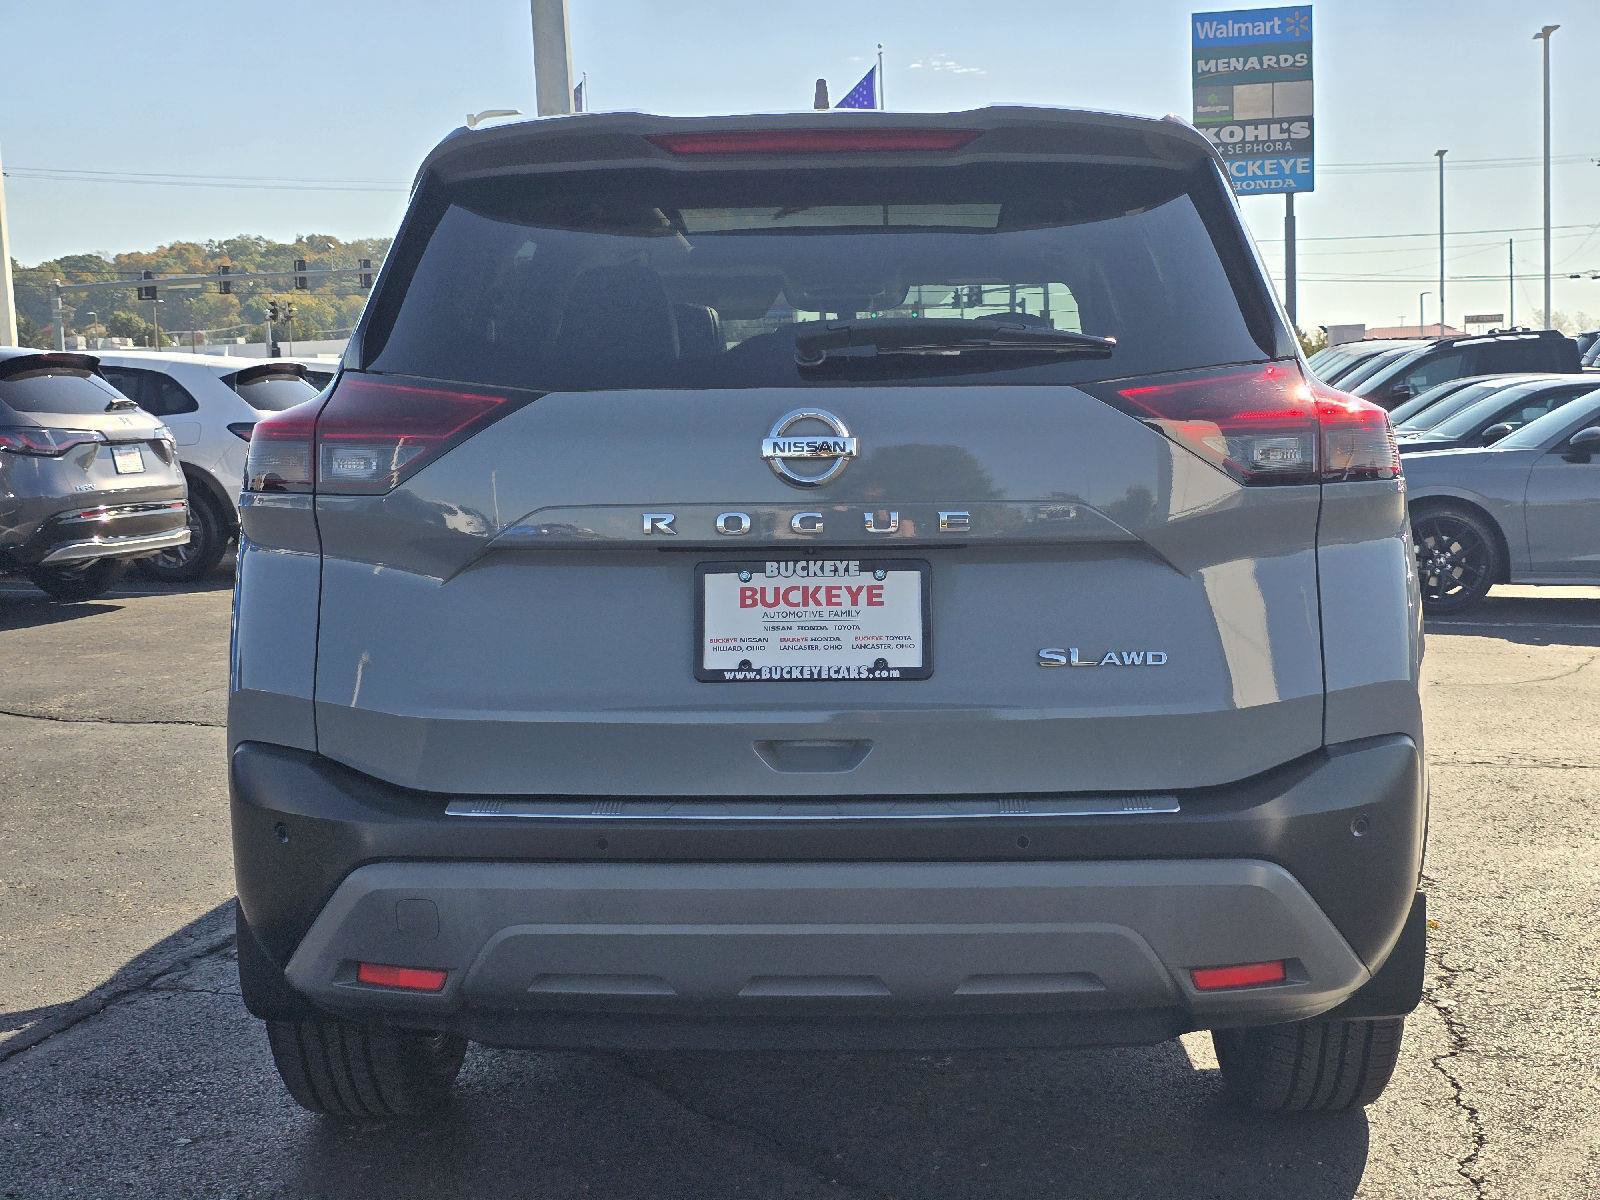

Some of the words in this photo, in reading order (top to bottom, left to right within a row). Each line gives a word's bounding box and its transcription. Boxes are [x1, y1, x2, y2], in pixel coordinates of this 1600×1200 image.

[1196, 17, 1281, 39] Walmart
[1197, 53, 1308, 73] MENARDS
[772, 441, 847, 453] NISSAN
[642, 512, 971, 535] ROGUE
[765, 560, 861, 577] BUCKEYE
[739, 585, 885, 608] BUCKEYE
[762, 611, 824, 619] AUTOMOTIVE
[1038, 647, 1098, 667] SL
[1100, 651, 1168, 666] AWD
[723, 665, 900, 680] www.BUCKEYECARS.com
